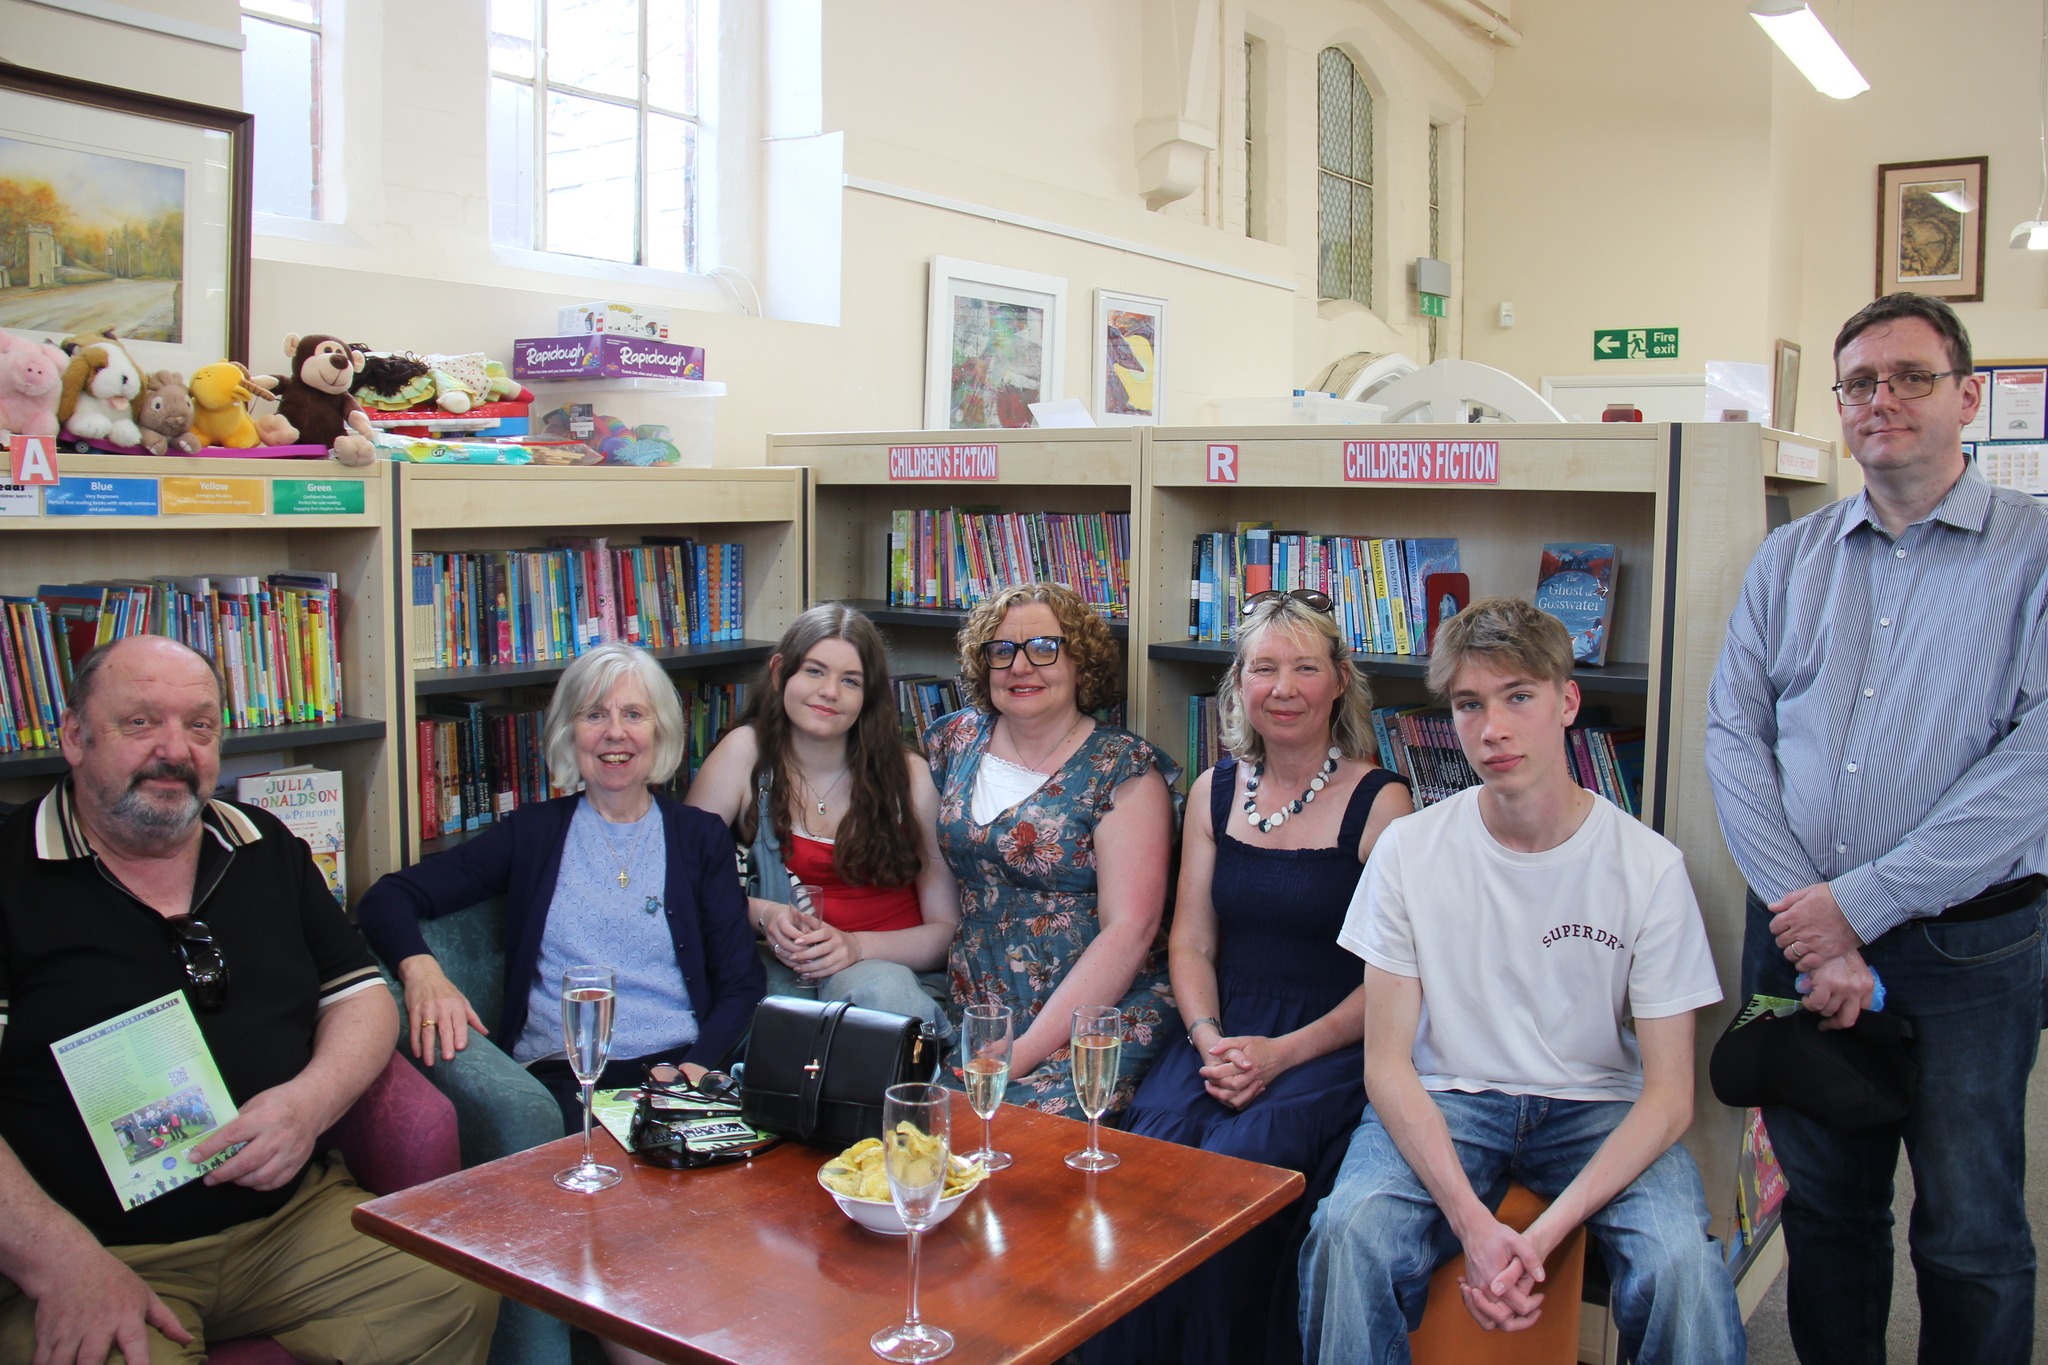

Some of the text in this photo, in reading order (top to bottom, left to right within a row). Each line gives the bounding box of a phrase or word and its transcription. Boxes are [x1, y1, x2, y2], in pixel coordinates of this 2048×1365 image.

[1653, 331, 1676, 343] Fire
[526, 343, 585, 368] Rapidough
[1653, 343, 1676, 355] exit
[619, 346, 686, 374] Rapidough
[20, 438, 54, 481] A
[890, 446, 996, 478] CHILDREN'S FICTION
[1209, 446, 1235, 481] R
[1345, 442, 1497, 480] CHILDREN'S FICTION
[91, 482, 113, 491] Blue
[199, 482, 229, 491] Yellow
[307, 483, 332, 492] Green
[1373, 543, 1381, 569] Nathalia
[1408, 545, 1418, 583] Holly Webb
[1387, 543, 1398, 598] Nathalia BUTTFACE
[1376, 570, 1384, 597] BUTTFACE
[1549, 583, 1584, 596] Ghost
[1538, 597, 1602, 611] Gosswater
[1561, 610, 1578, 619] Lucy
[1565, 618, 1591, 628] Strange
[265, 777, 314, 794] JULIA
[249, 789, 338, 808] DONALDSON
[293, 809, 336, 820] PERFORM
[61, 999, 177, 1052] THE WAR MEMORIAL TRAIL
